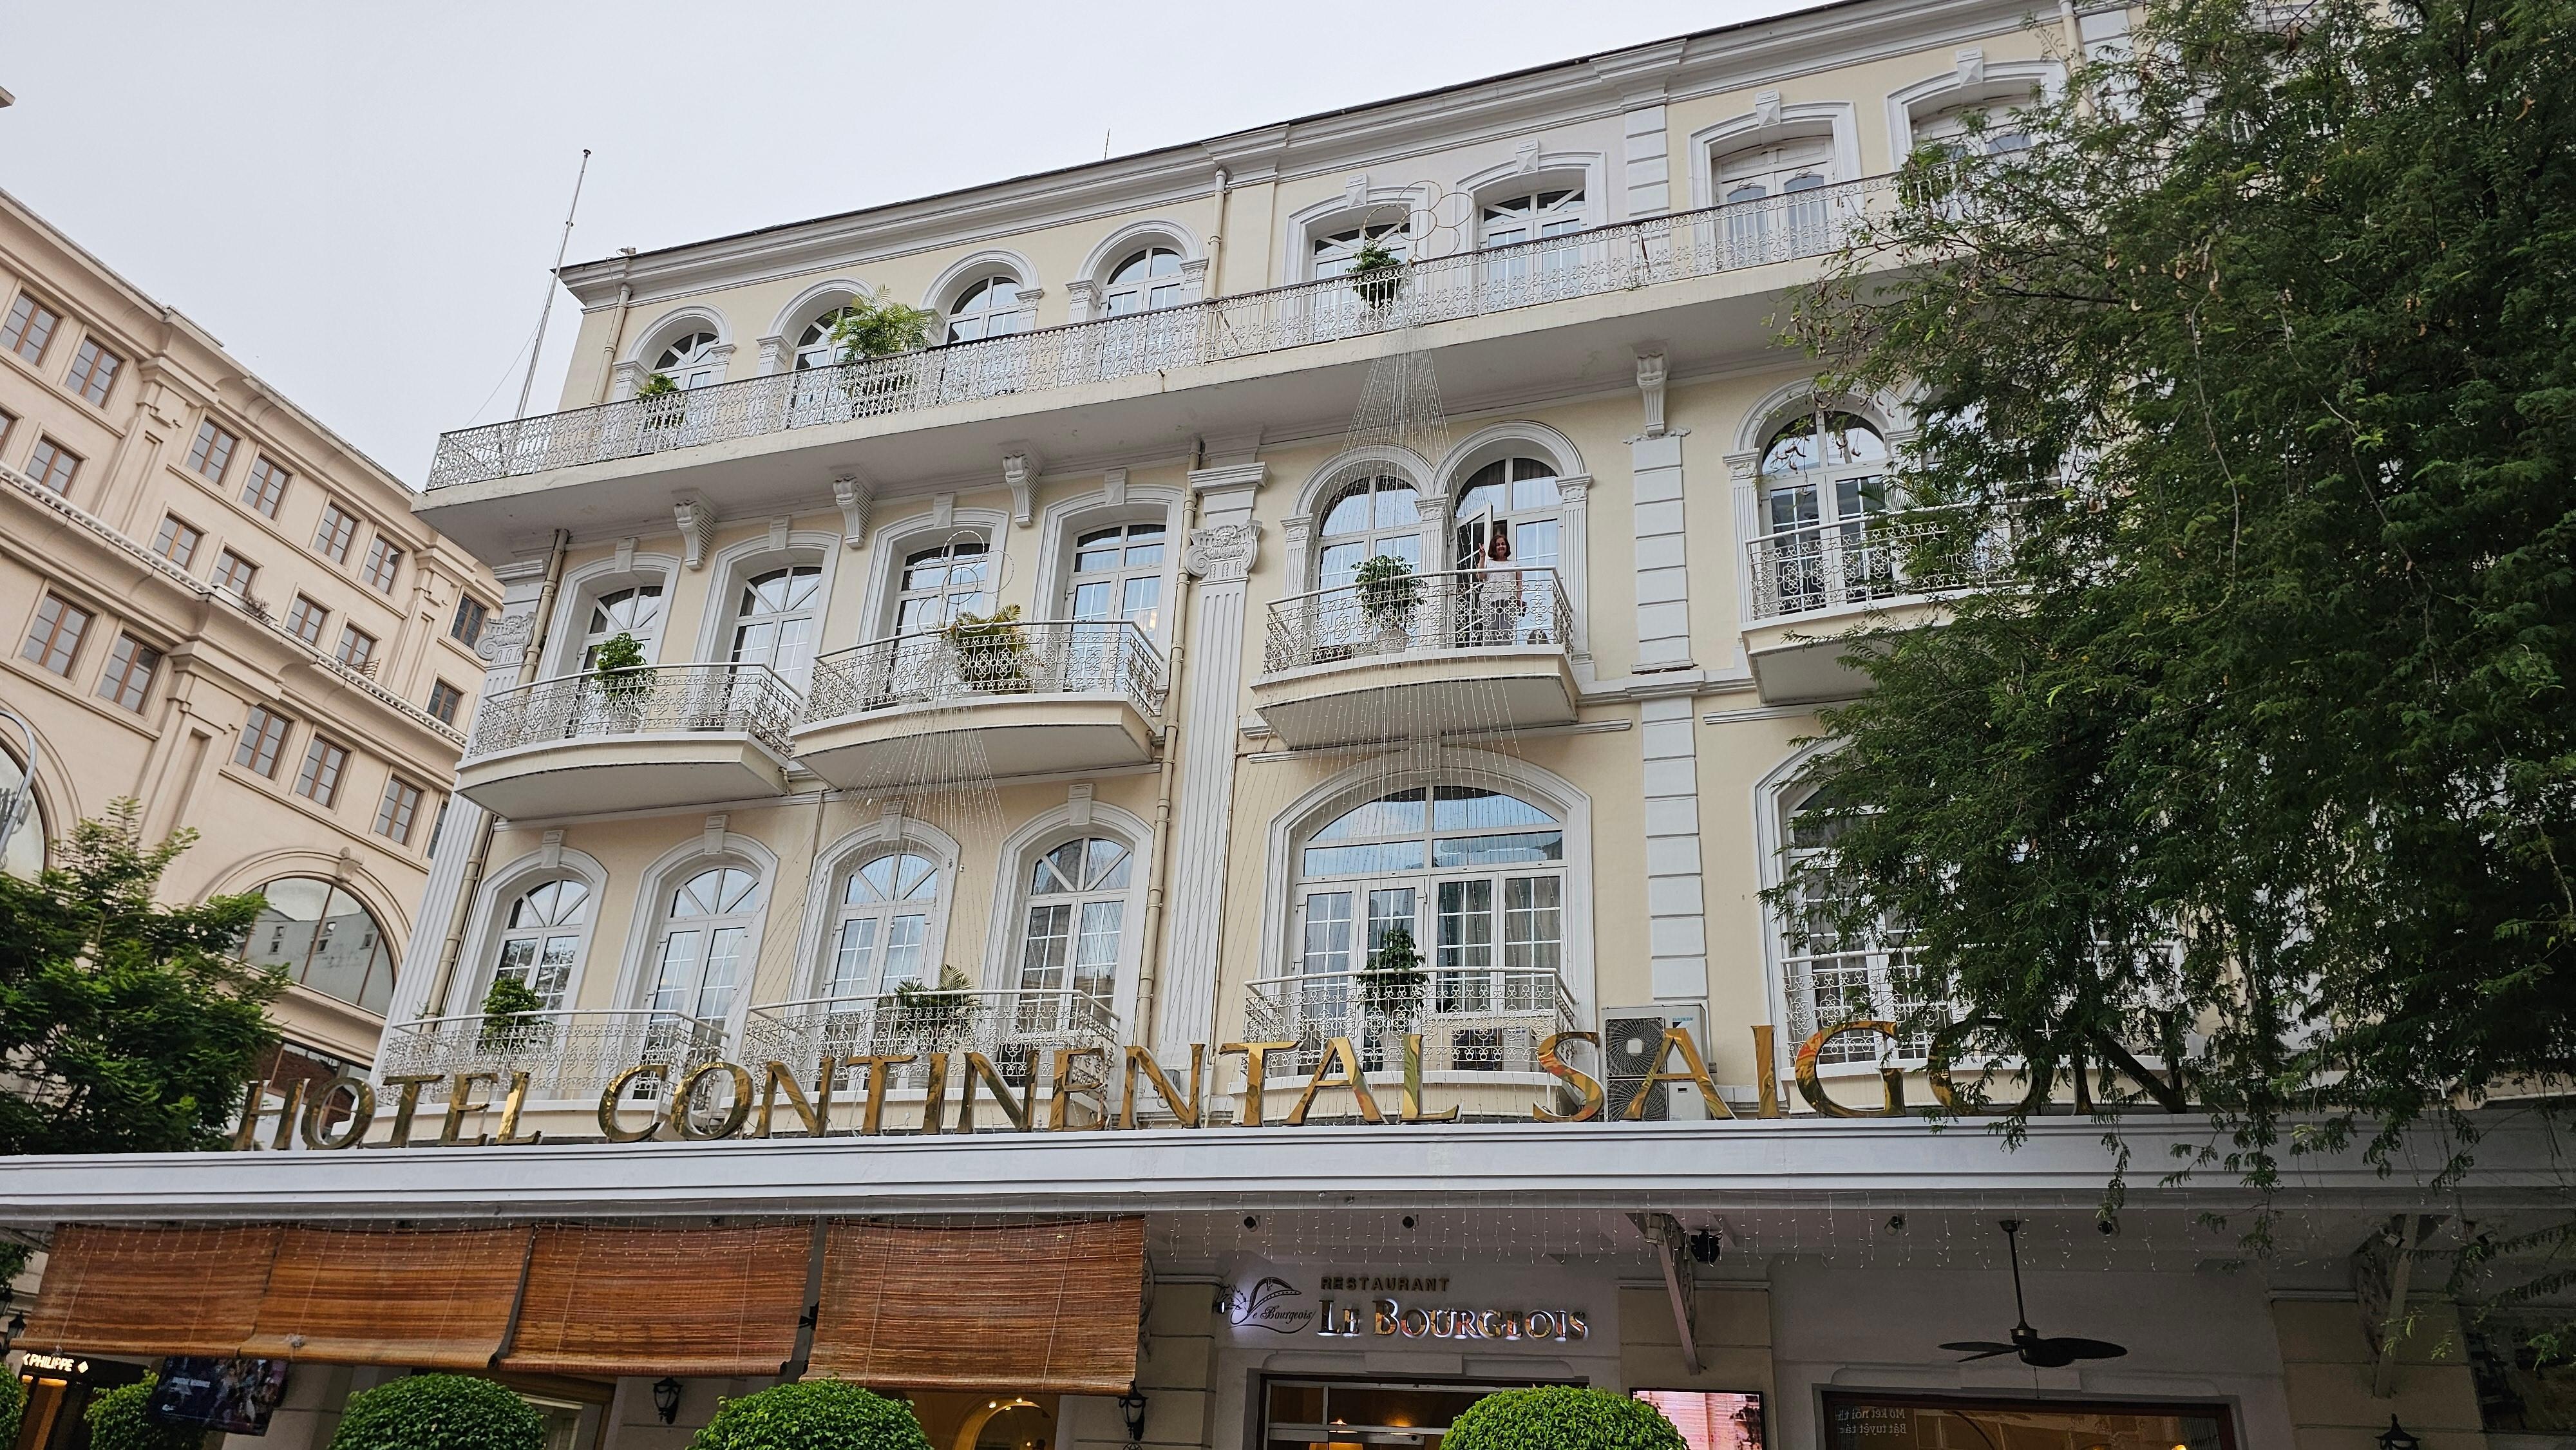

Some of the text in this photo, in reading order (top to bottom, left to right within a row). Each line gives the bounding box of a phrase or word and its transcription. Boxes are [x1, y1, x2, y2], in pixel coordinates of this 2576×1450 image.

[232, 1010, 2192, 1151] HOTEL CONTINENTAL SAIGON
[1321, 1276, 1450, 1292] RESTAURANT
[1260, 1305, 1315, 1324] Bourgeois
[1318, 1298, 1588, 1341] LE BOURGEOIS
[28, 1353, 75, 1372] PHILIPPE
